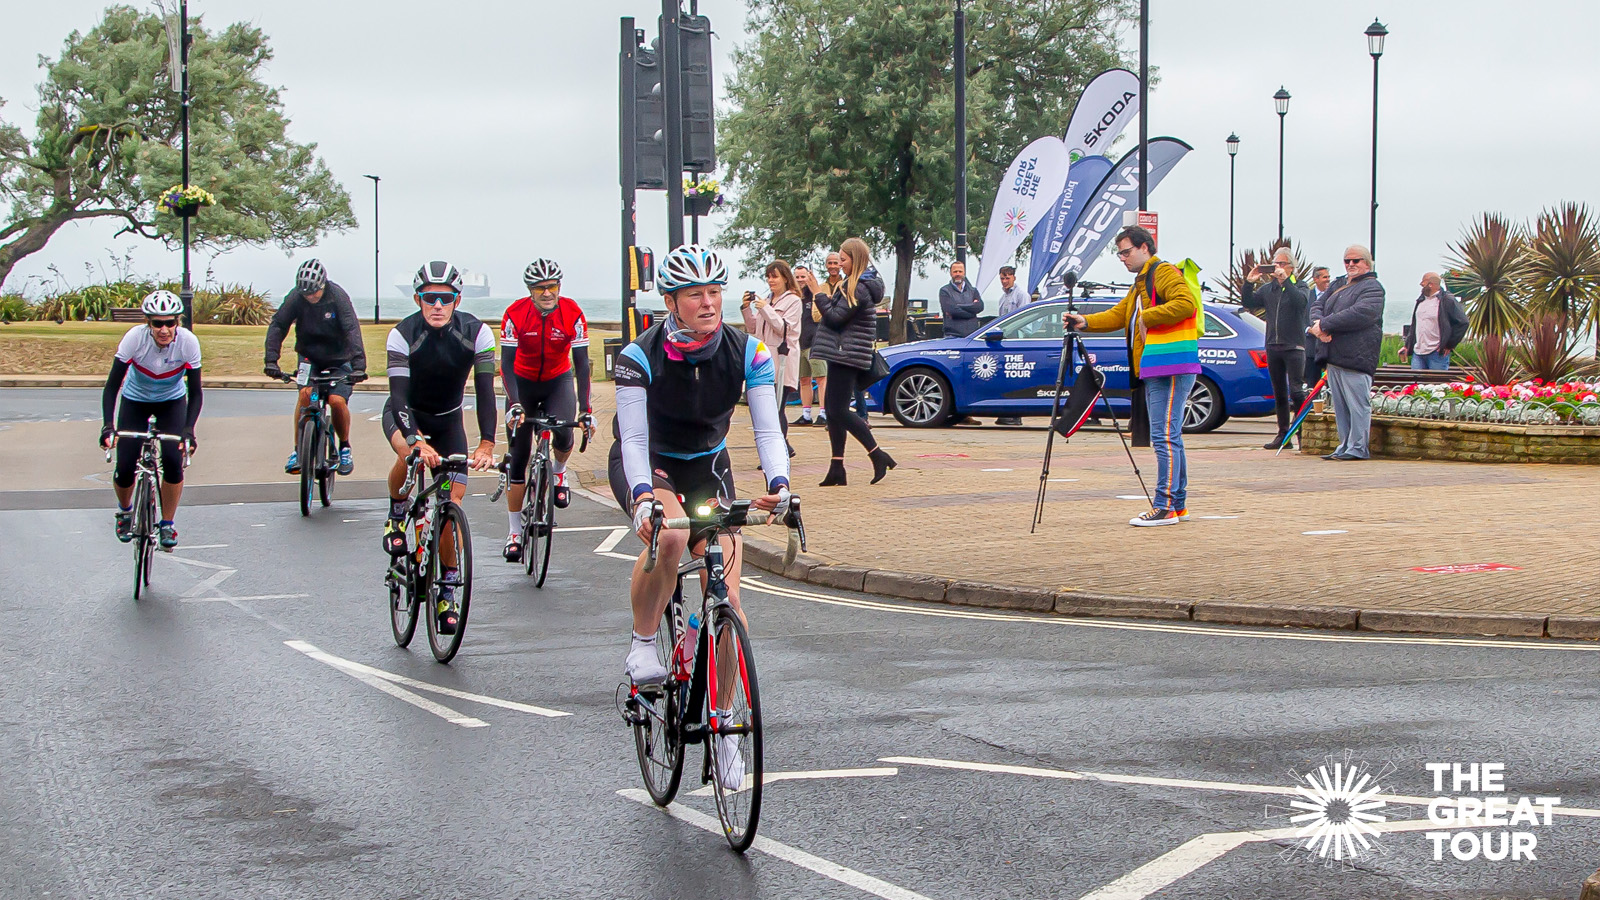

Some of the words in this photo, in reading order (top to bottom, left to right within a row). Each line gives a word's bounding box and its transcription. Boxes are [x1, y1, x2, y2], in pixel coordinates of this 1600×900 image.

[1083, 91, 1136, 148] ŠKODA
[1197, 349, 1237, 358] KODA
[1004, 354, 1024, 362] THE
[1004, 362, 1036, 370] GREAT
[1004, 370, 1031, 378] TOUR
